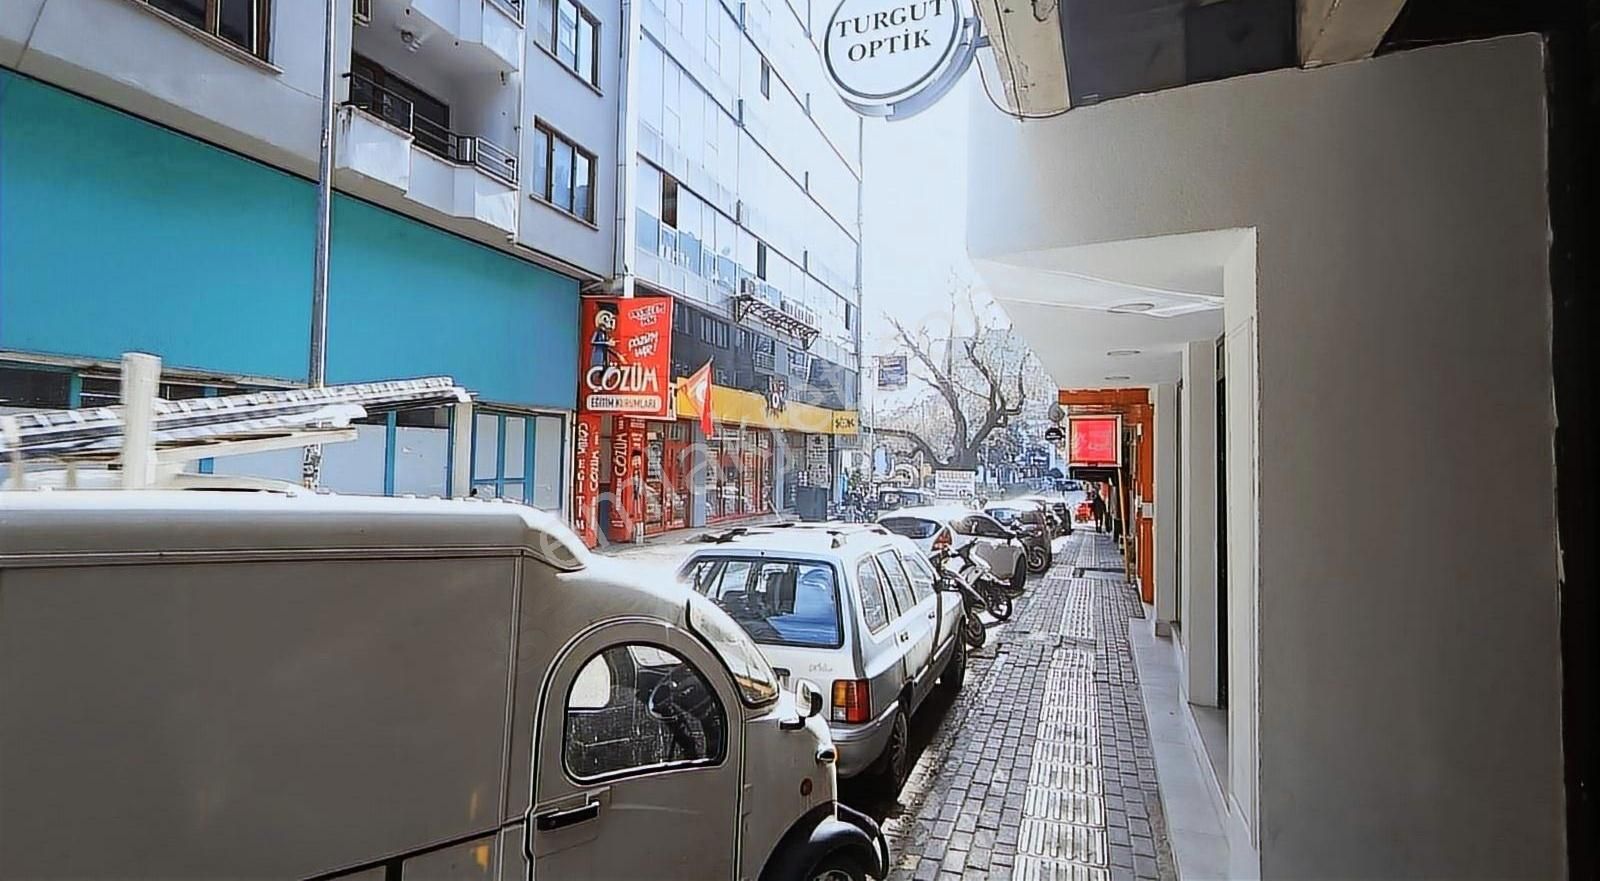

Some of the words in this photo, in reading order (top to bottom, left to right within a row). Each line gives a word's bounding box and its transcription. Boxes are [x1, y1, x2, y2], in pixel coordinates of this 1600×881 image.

[836, 0, 947, 38] TURGUT
[847, 28, 931, 63] OPTİK
[586, 362, 659, 393] ÇÖZÜM
